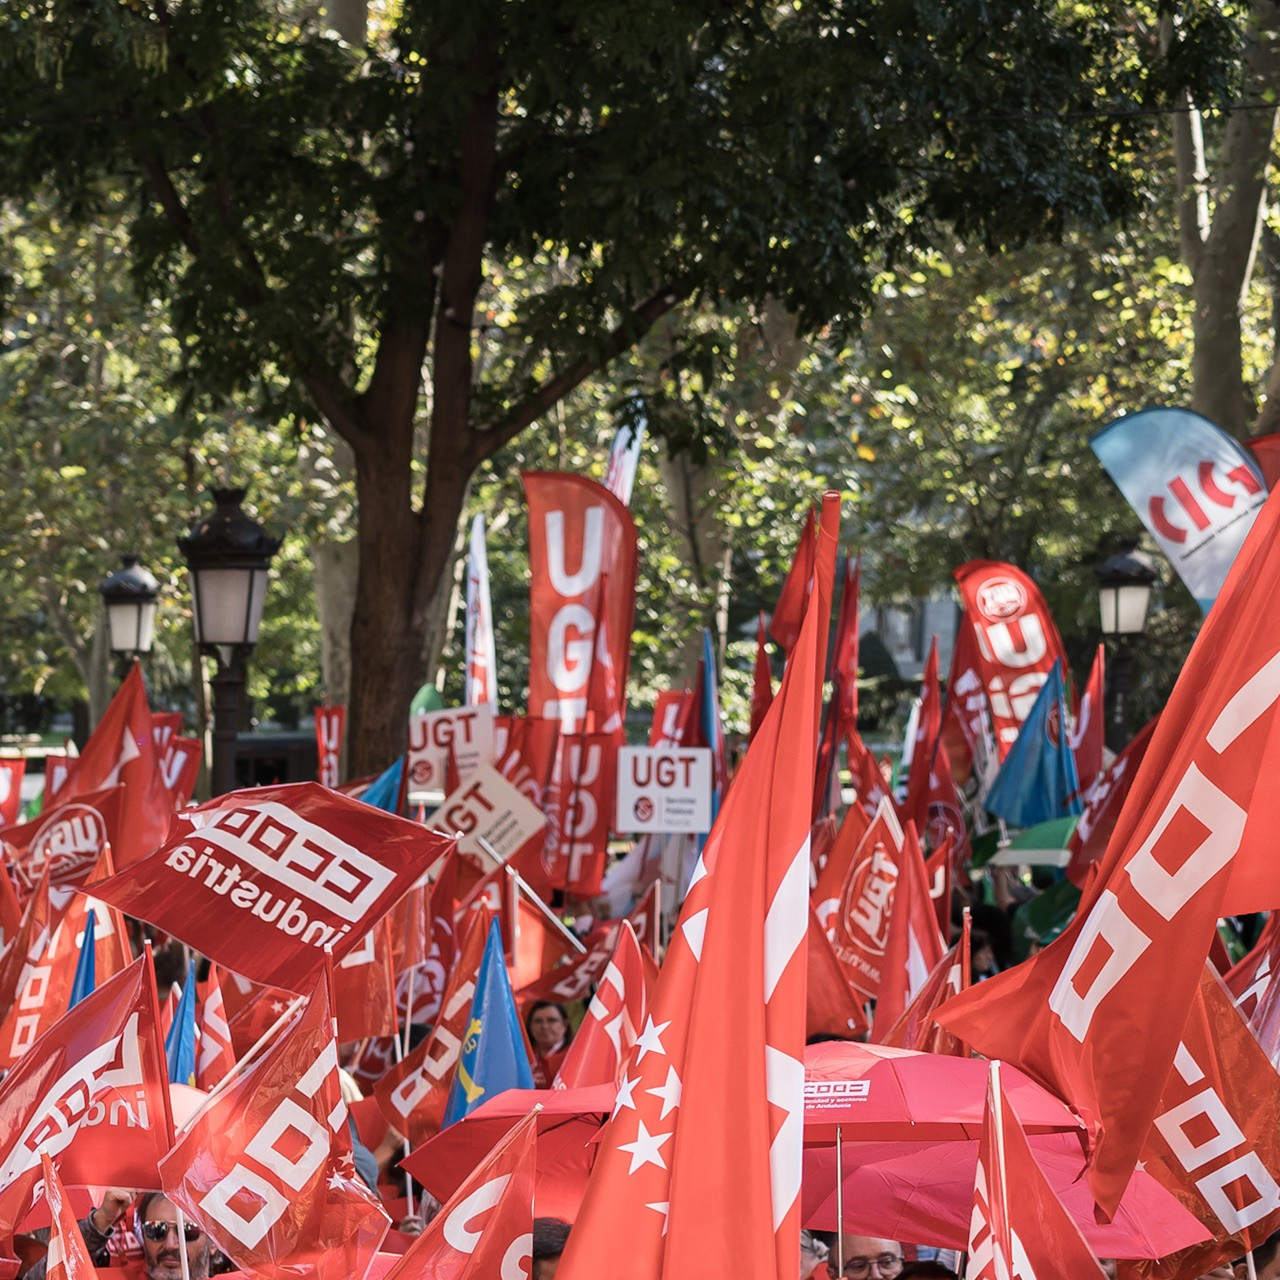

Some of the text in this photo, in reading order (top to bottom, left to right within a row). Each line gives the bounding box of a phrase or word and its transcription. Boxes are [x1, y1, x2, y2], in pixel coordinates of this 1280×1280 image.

[1148, 460, 1262, 544] CIG
[543, 506, 607, 735] UGT
[410, 712, 477, 750] UGT
[632, 755, 696, 788] UGT
